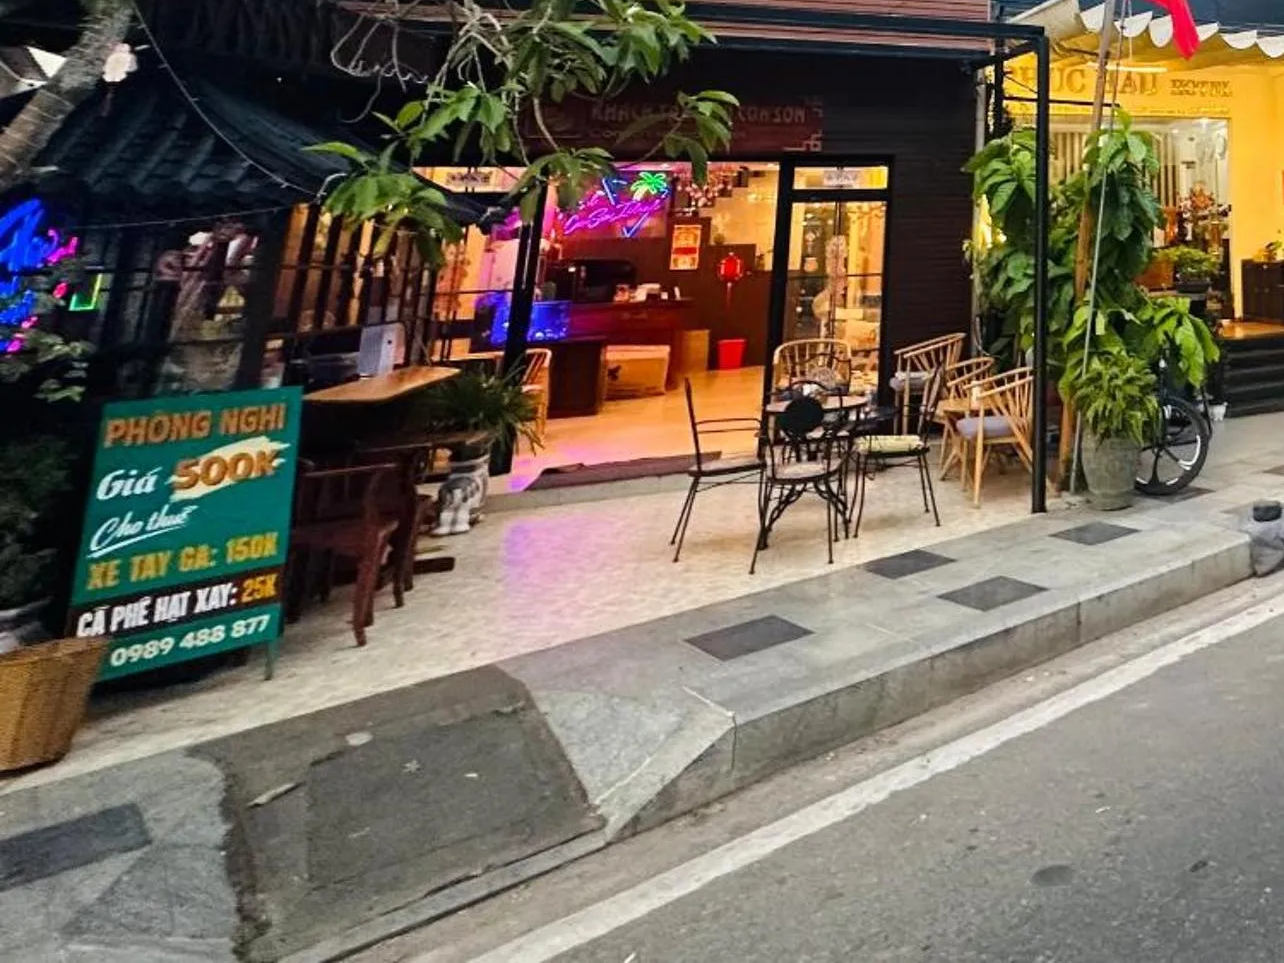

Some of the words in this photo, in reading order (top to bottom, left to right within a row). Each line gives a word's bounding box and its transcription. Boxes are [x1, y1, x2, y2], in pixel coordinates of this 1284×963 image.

[96, 467, 163, 500] Giá
[171, 448, 280, 492] 500K
[90, 511, 144, 551] Cho
[87, 559, 121, 590] XE
[129, 550, 172, 582] TAY
[178, 544, 217, 573] GA:
[226, 532, 279, 564] 150K
[109, 596, 152, 632] PHÊ
[193, 582, 239, 614] XAY:
[240, 573, 279, 602] 25K
[109, 637, 176, 668] 0989
[231, 614, 271, 638] 877
